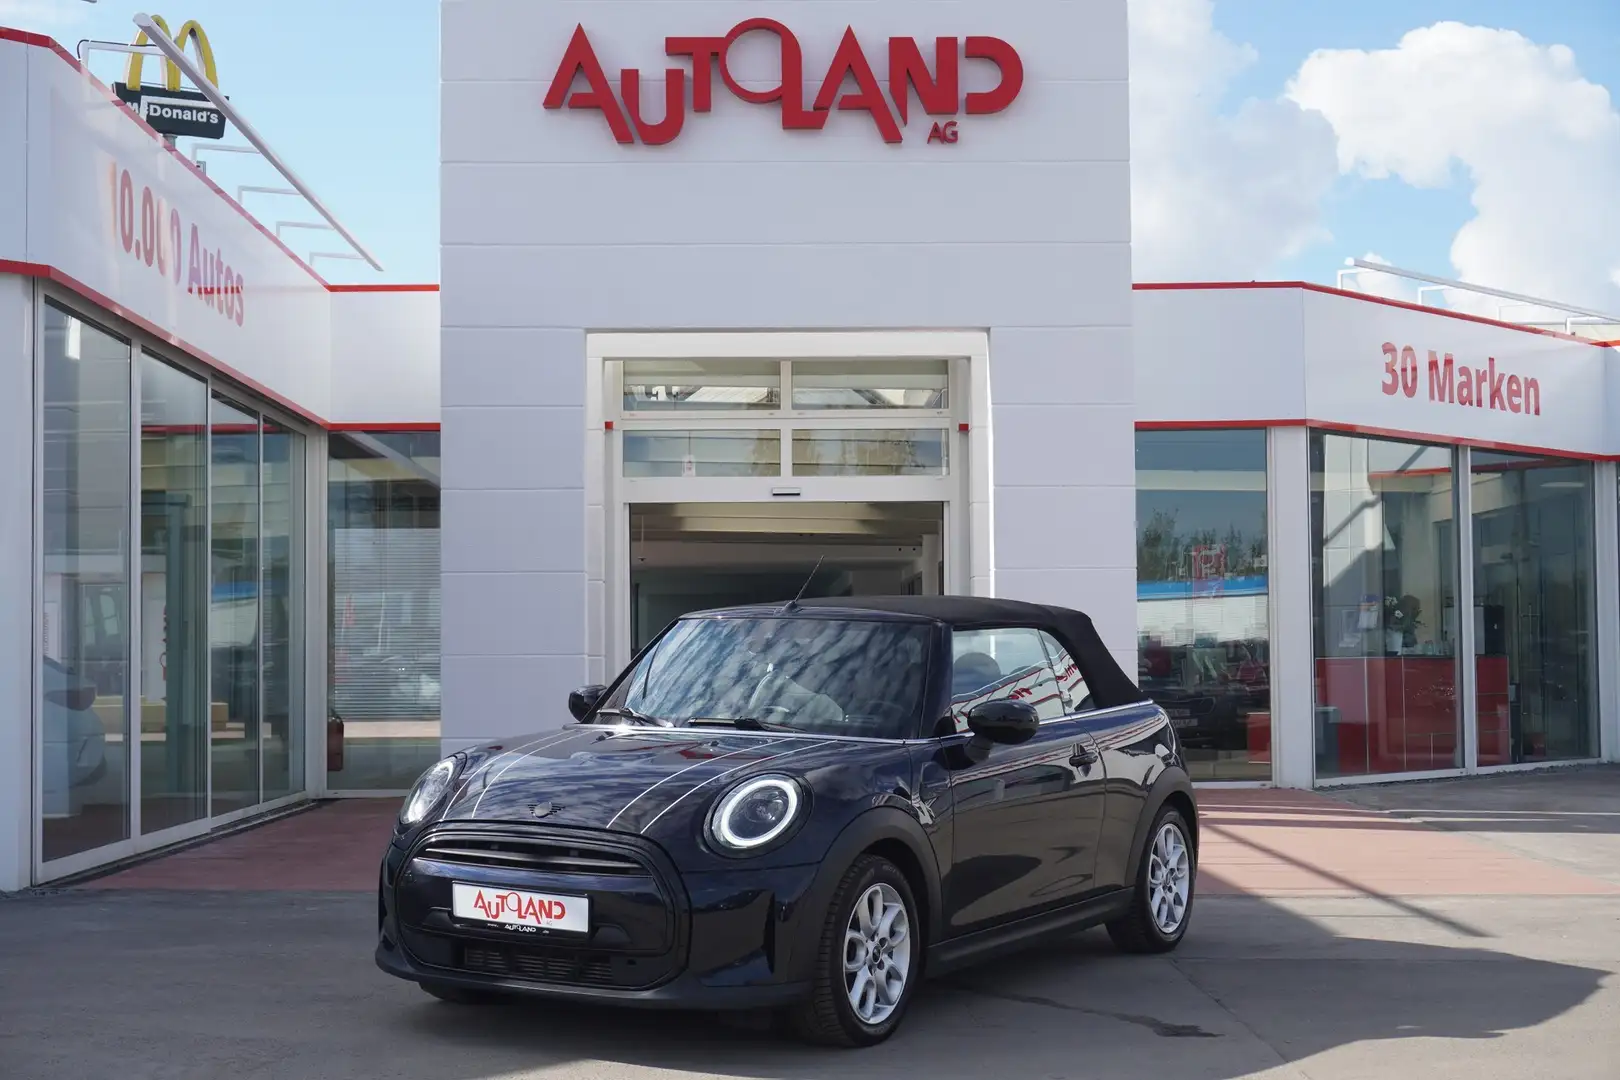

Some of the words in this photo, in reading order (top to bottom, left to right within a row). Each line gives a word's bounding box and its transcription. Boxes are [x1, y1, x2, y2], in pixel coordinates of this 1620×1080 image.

[927, 120, 959, 145] AG
[187, 222, 245, 328] Autos
[1381, 341, 1418, 399] 30
[1427, 349, 1541, 416] Marken
